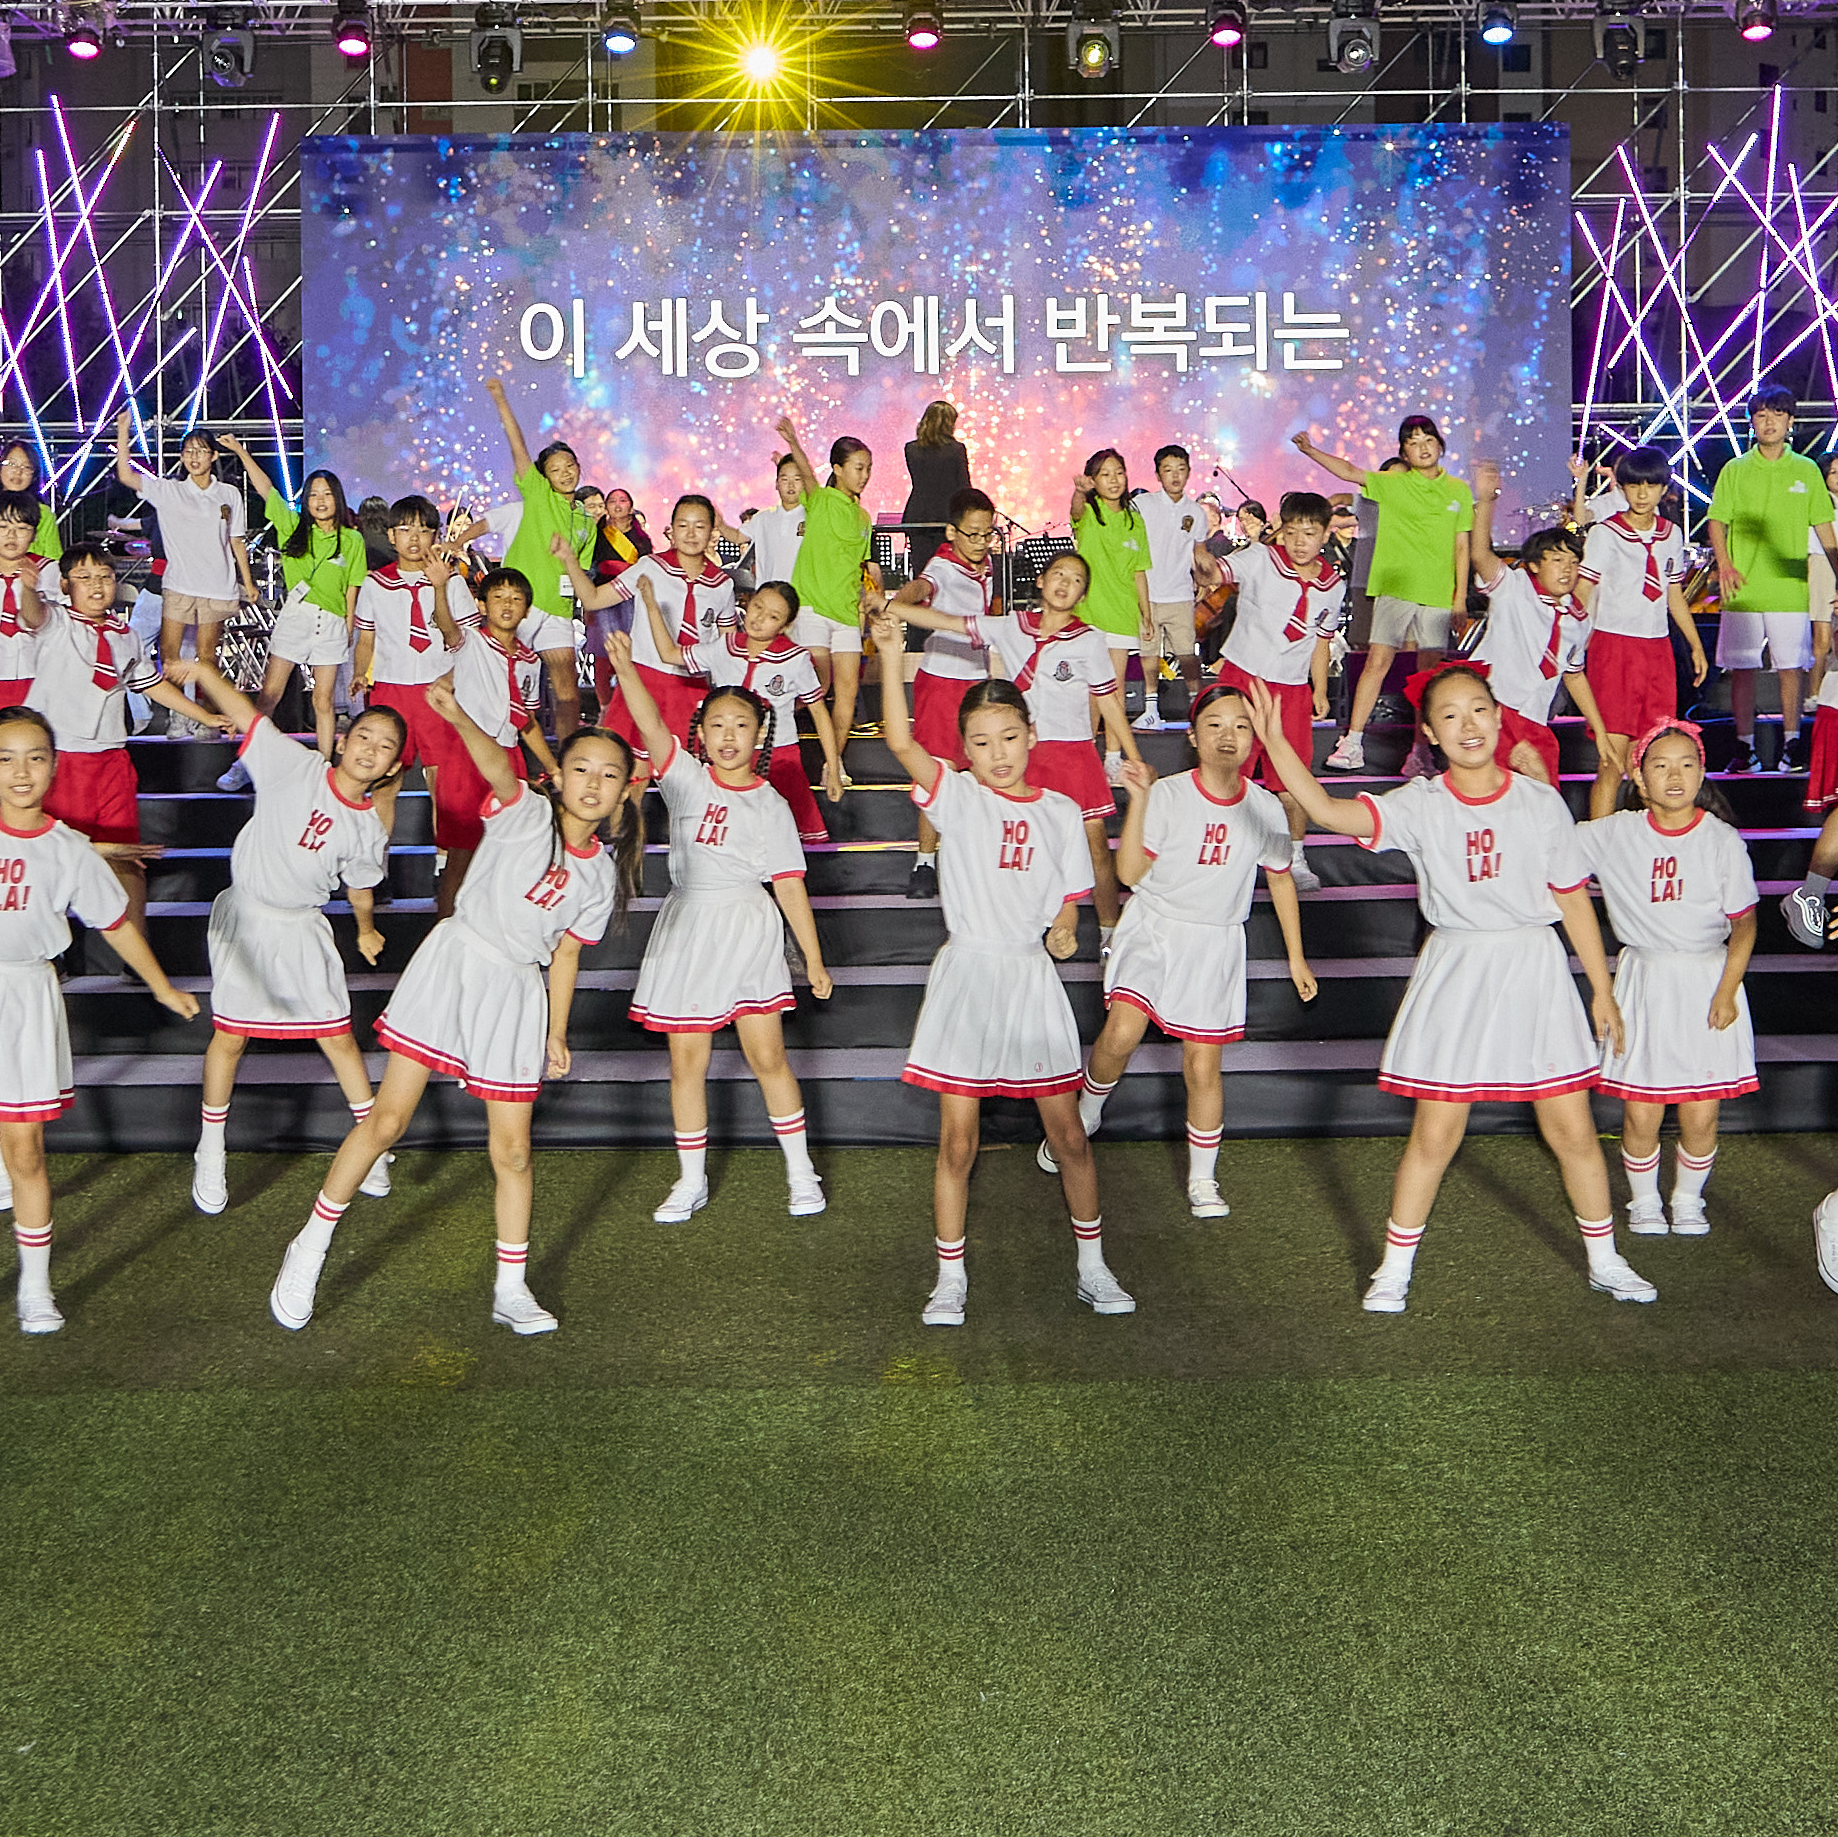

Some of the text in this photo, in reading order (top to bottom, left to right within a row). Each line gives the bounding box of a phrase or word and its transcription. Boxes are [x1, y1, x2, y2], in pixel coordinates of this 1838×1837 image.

[519, 291, 1351, 378] 이 세상 속에서 반복되는
[704, 803, 728, 824] HO
[694, 824, 729, 846] LA!
[1002, 820, 1030, 845] HO
[1204, 823, 1227, 844] HO
[1466, 828, 1495, 856] HO
[998, 845, 1035, 871] LA!
[1197, 845, 1231, 866] LA!
[1466, 853, 1502, 882] LA!
[1652, 856, 1678, 879] HO
[524, 881, 566, 911] LA!
[1650, 879, 1683, 903] LA!
